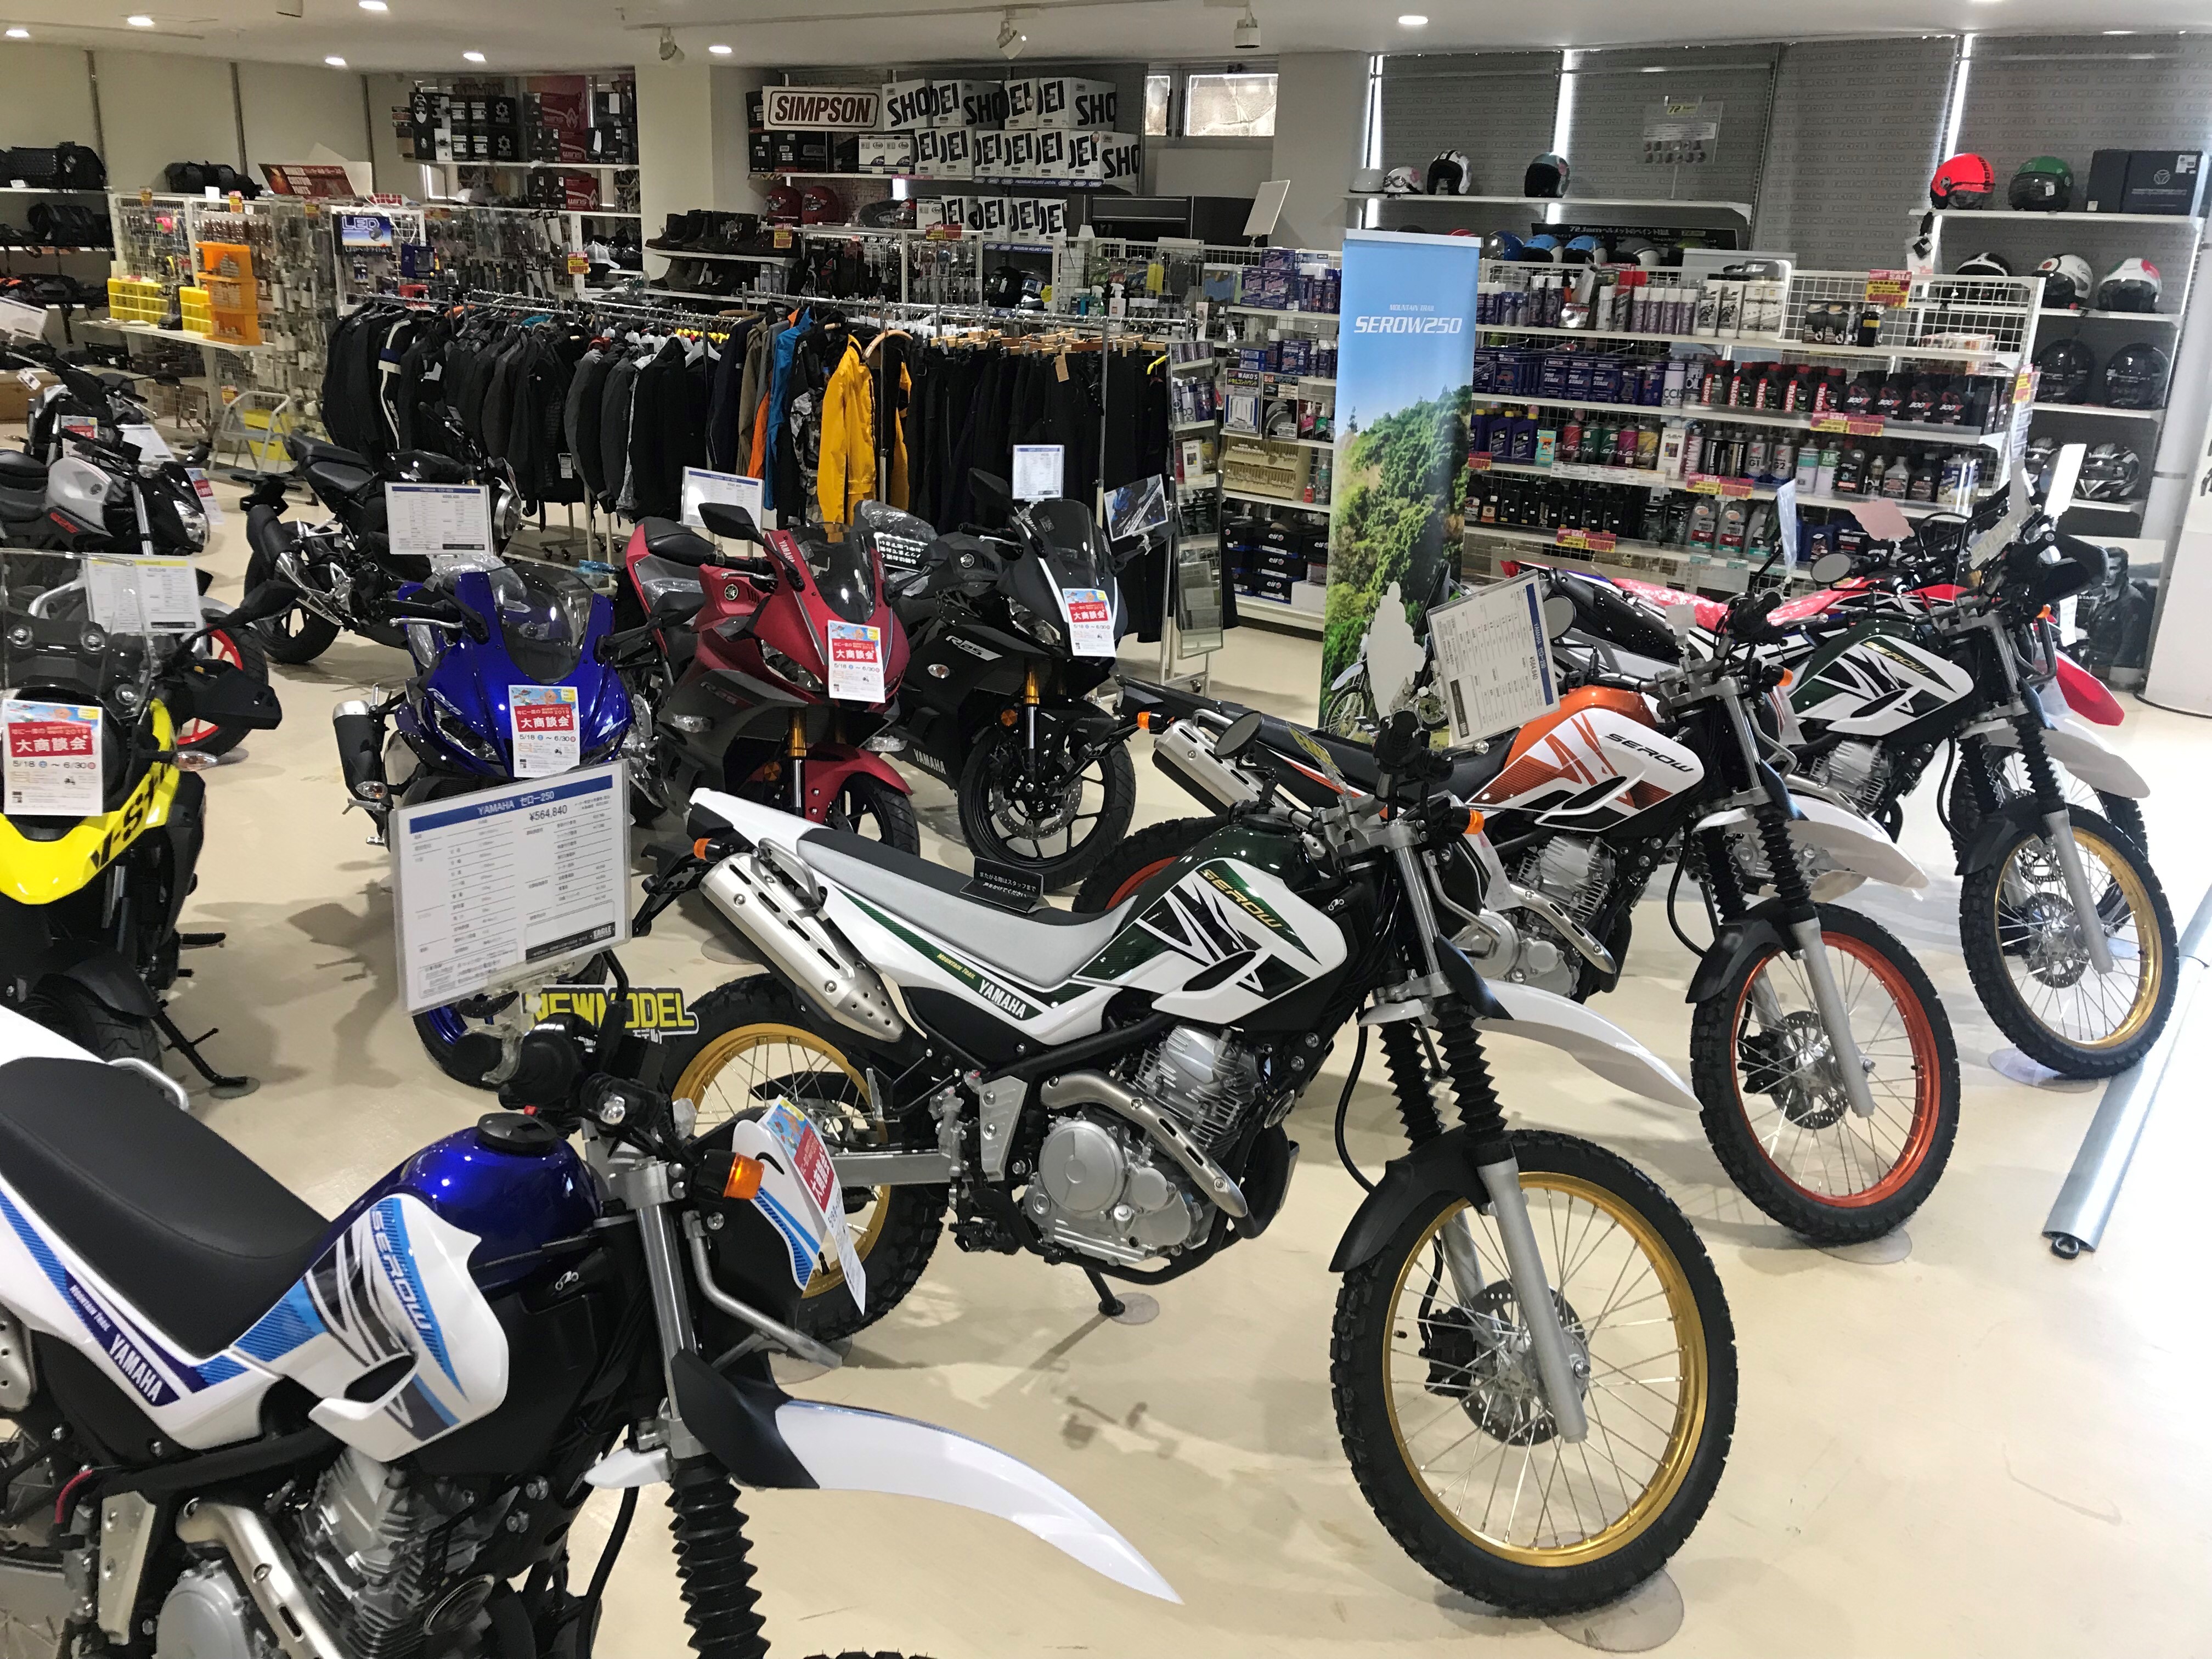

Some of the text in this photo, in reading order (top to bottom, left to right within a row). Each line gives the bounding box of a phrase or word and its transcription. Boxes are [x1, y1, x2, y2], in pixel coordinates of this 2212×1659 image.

[775, 95, 871, 122] SIMPSON
[342, 216, 380, 231] LED
[1354, 316, 1463, 334] SEROW250
[778, 540, 795, 562] YAMAHA
[1863, 641, 1931, 674] SEROW
[521, 715, 569, 729] 大商談会
[15, 737, 88, 753] 大商談会
[1605, 733, 1695, 772] SEROW
[913, 748, 946, 774] YAMAHA
[477, 800, 515, 815] YAMAHA
[529, 805, 568, 821] ¥564,840
[1201, 868, 1282, 929] SEROW
[937, 953, 975, 980] MOUNTAIN TRAIL
[978, 978, 1027, 1019] YAMAHA
[370, 1207, 431, 1331] SEROW
[69, 1284, 112, 1331] MOUNTAIN TRAIL
[108, 1333, 162, 1401] YAMAHA
